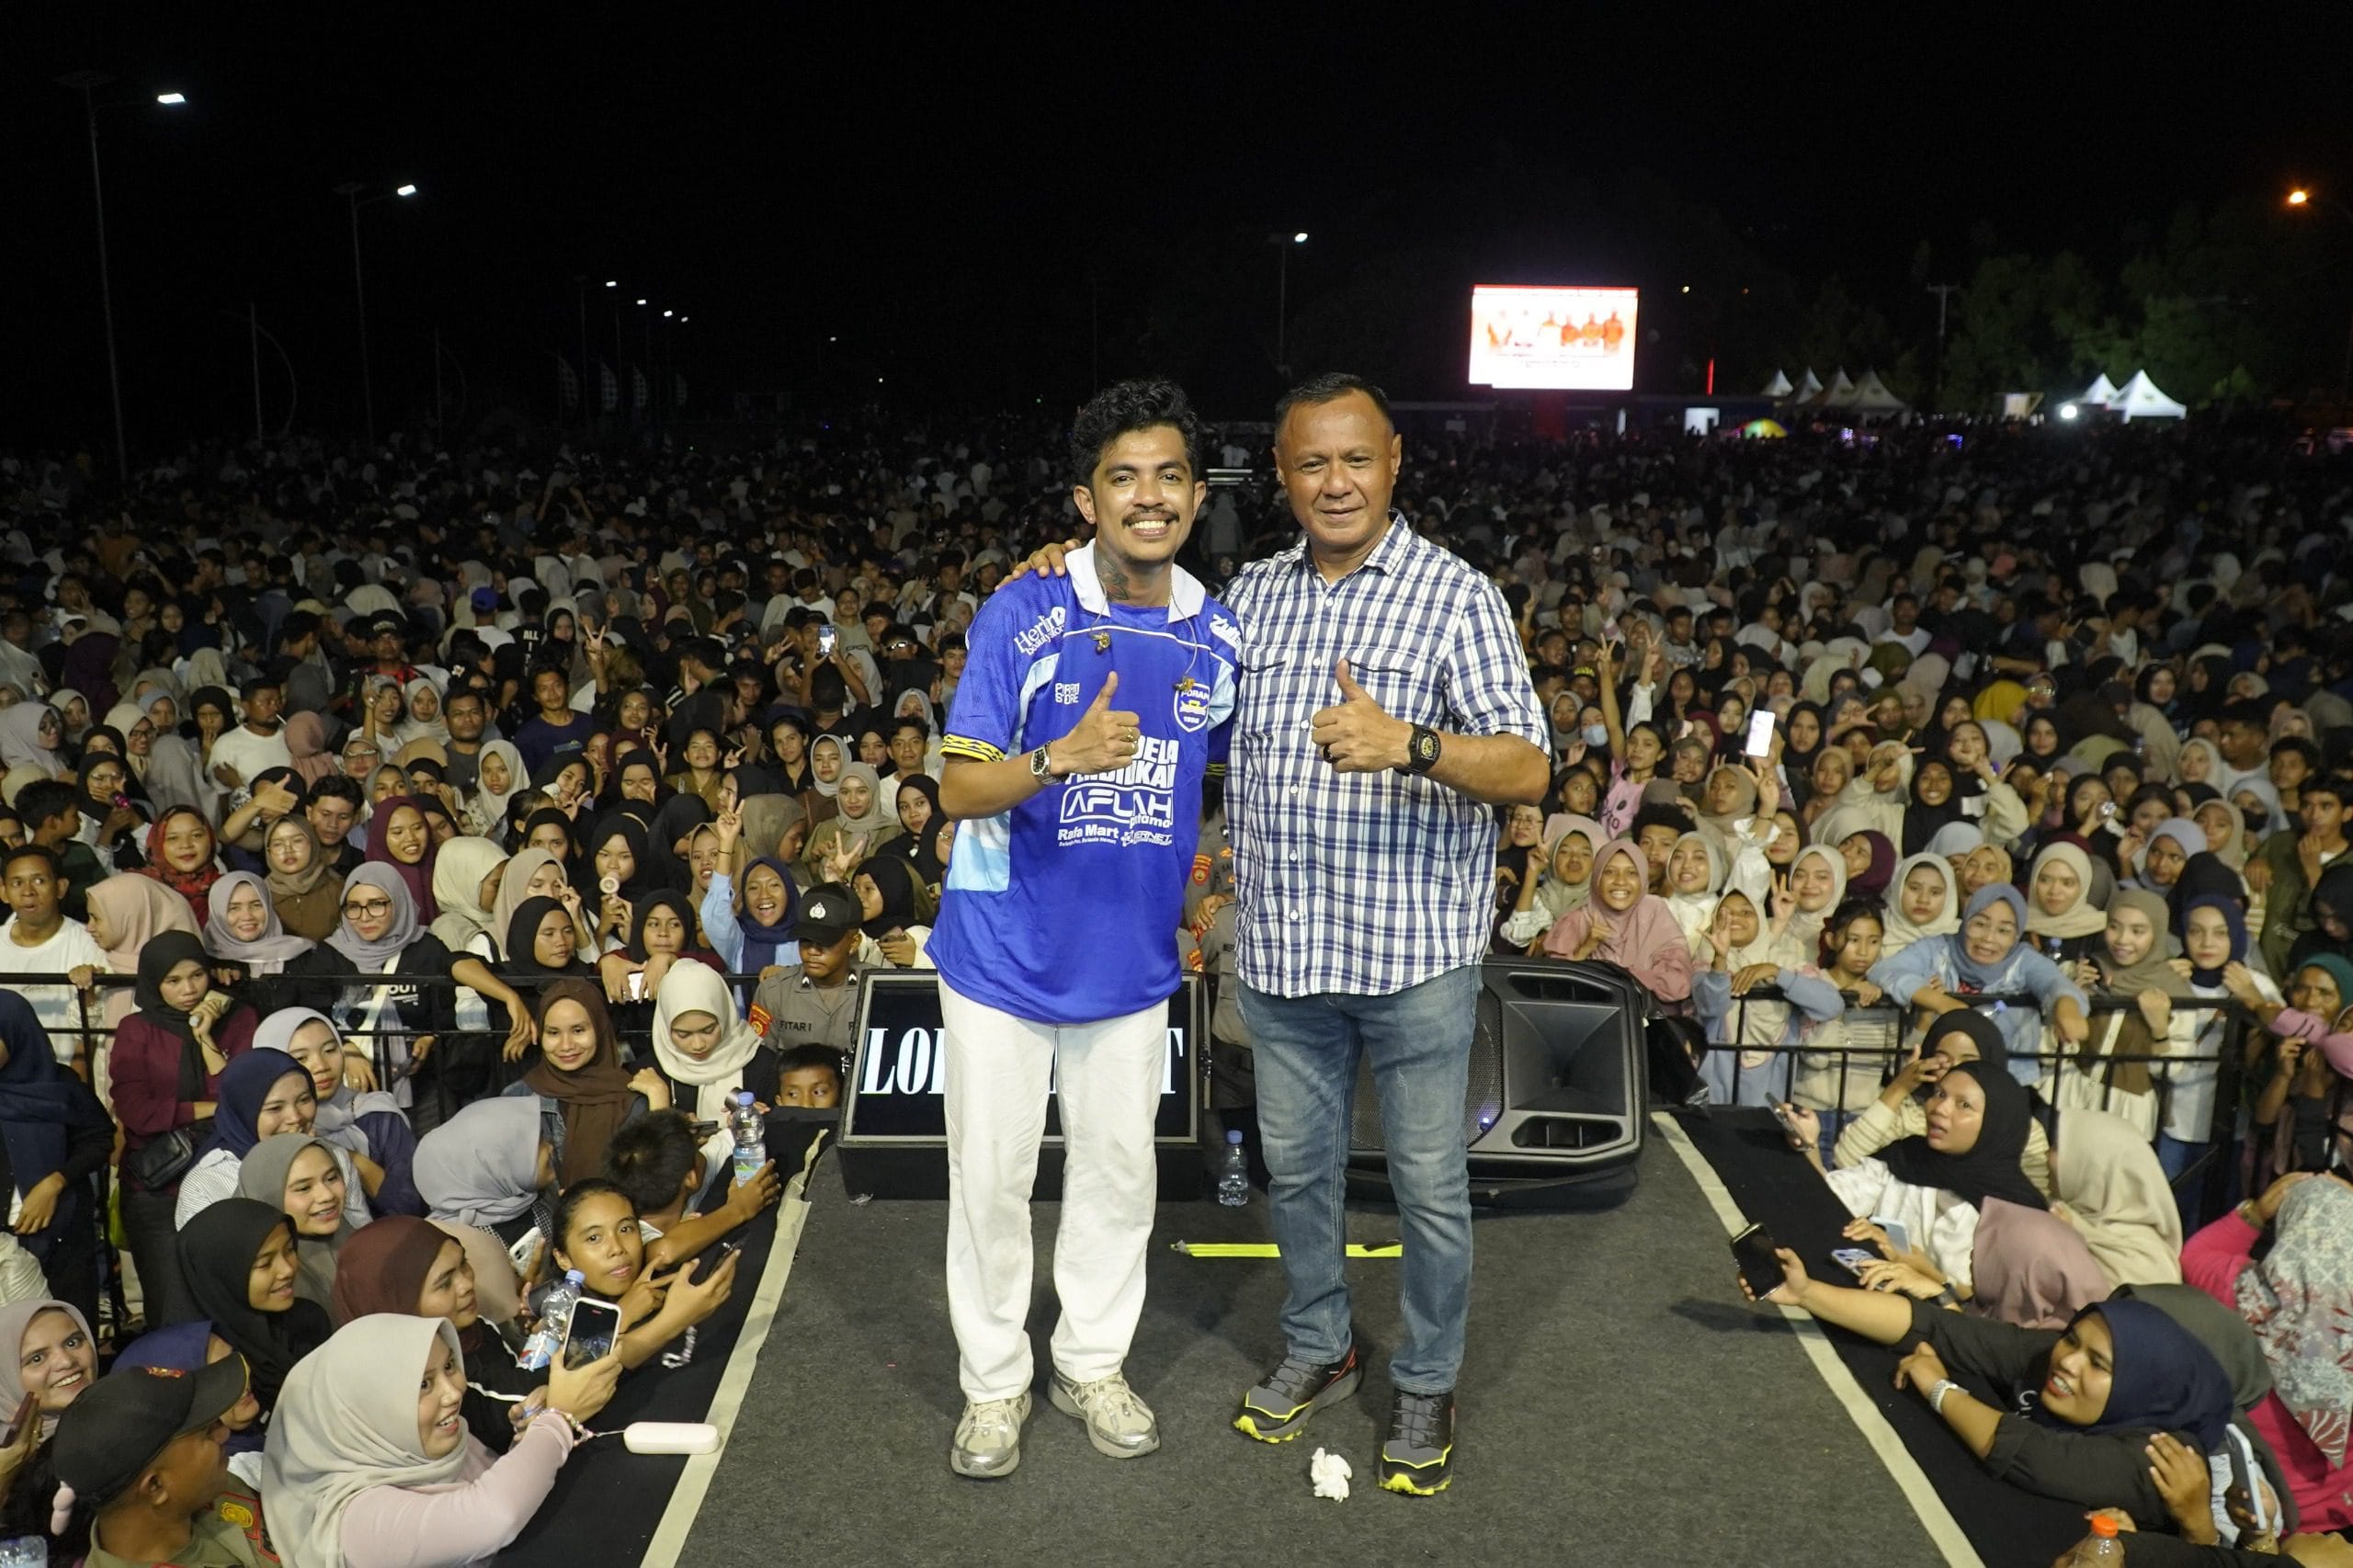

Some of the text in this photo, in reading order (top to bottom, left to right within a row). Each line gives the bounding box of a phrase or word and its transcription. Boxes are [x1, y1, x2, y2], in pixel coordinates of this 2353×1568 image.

[1066, 789, 1171, 819] AFLAH
[1058, 824, 1119, 840] Rafa Mart
